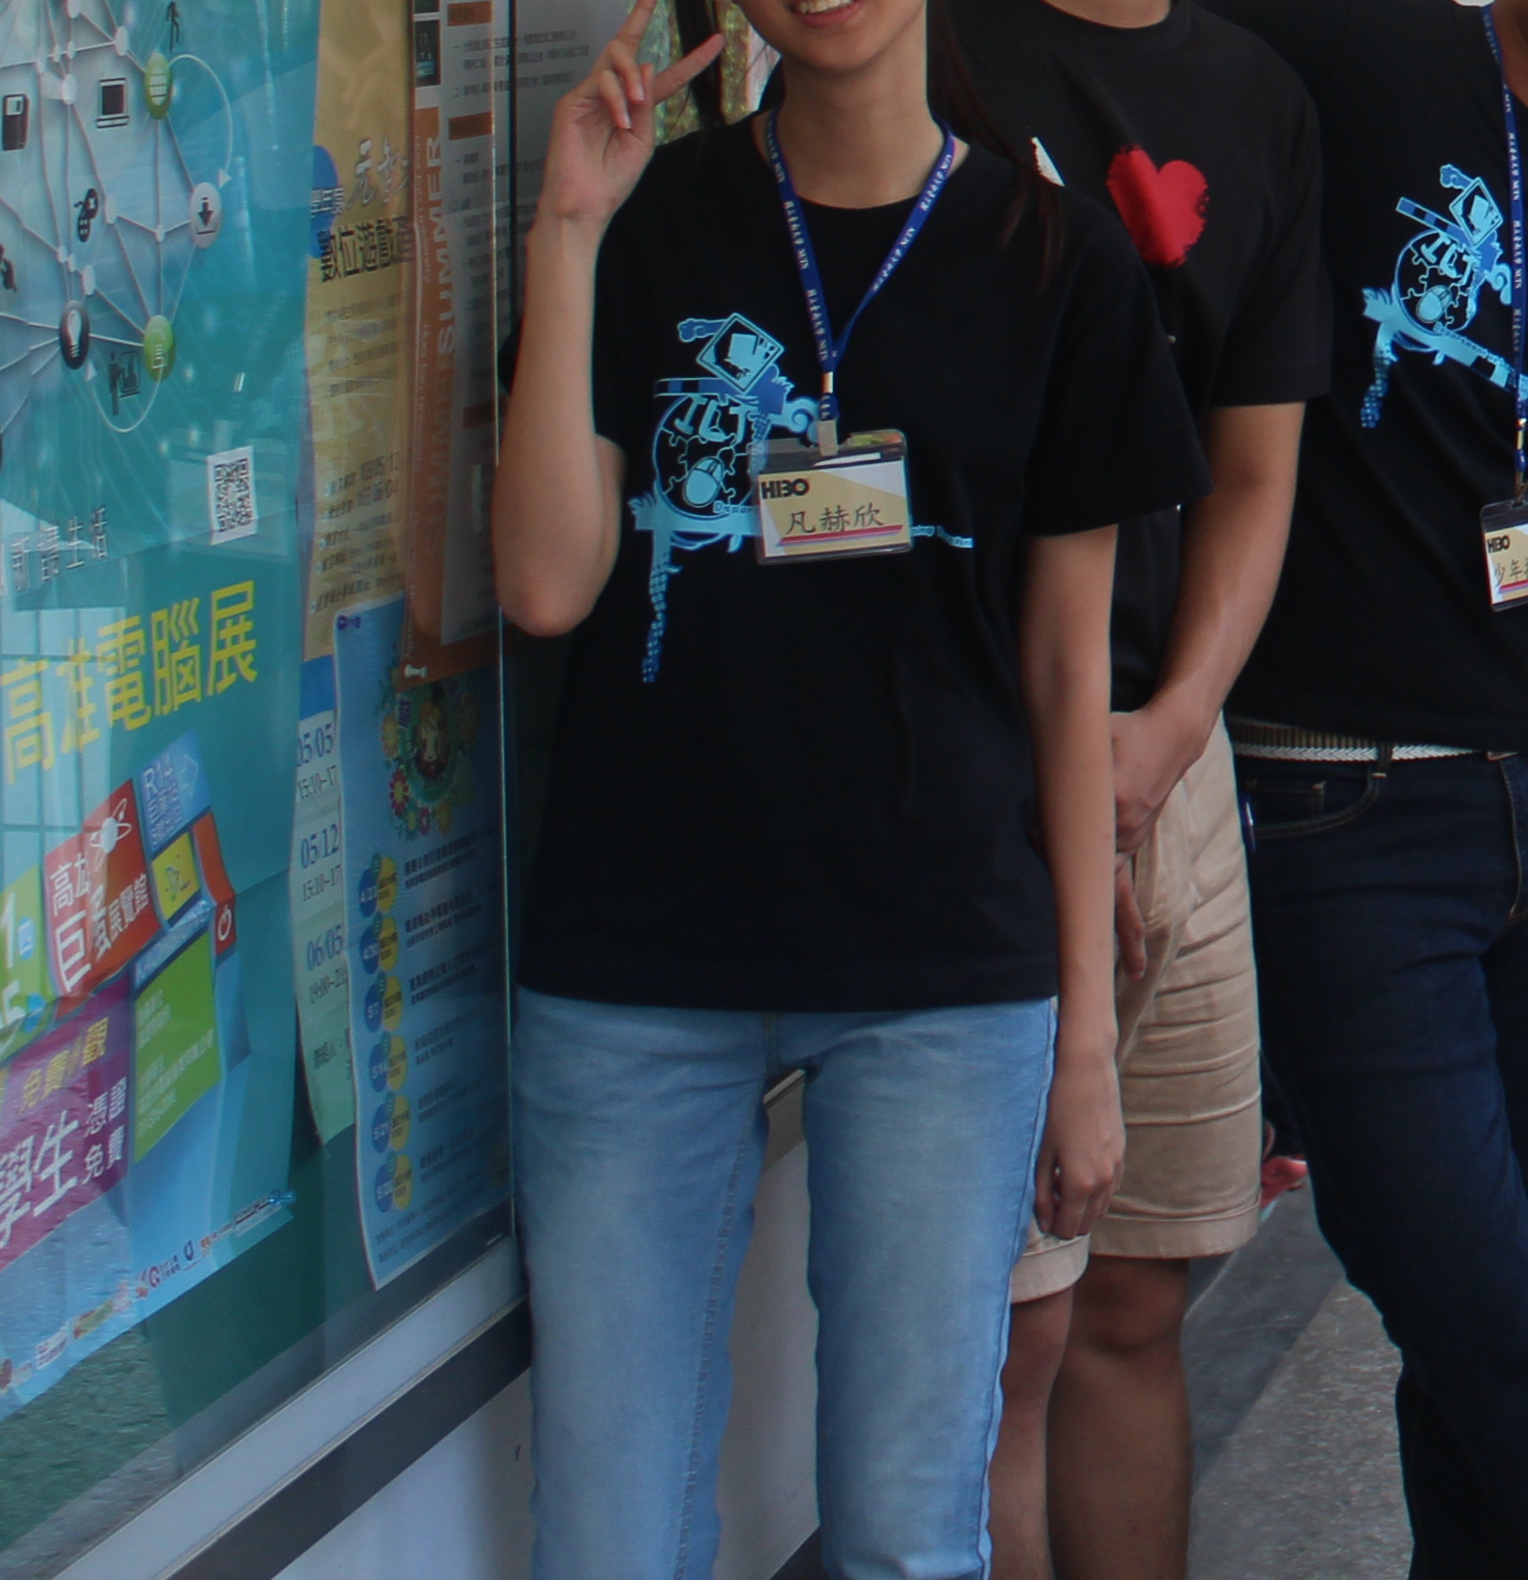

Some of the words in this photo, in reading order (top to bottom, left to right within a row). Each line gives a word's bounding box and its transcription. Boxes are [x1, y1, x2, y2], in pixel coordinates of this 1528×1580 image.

[0, 580, 258, 786] 高雄電腦展
[0, 1109, 80, 1249] 學生
